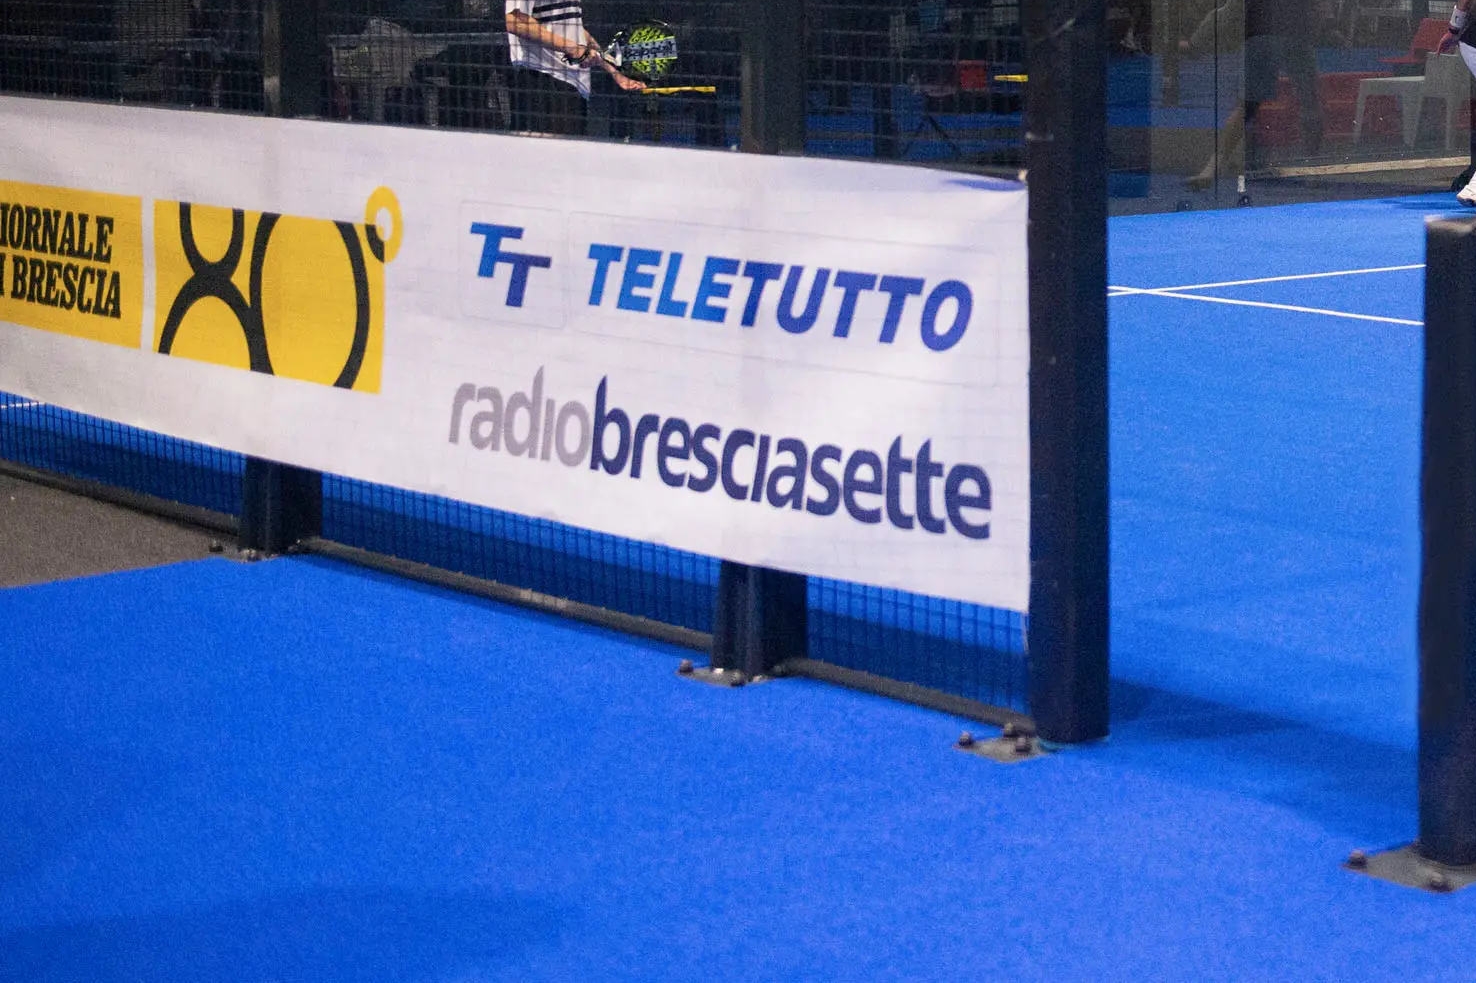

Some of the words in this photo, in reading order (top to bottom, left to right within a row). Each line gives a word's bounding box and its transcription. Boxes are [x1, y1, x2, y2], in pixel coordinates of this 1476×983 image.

[0, 202, 114, 264] IORNALE
[11, 254, 121, 319] BRESCIA
[587, 243, 974, 352] TELETUTTO
